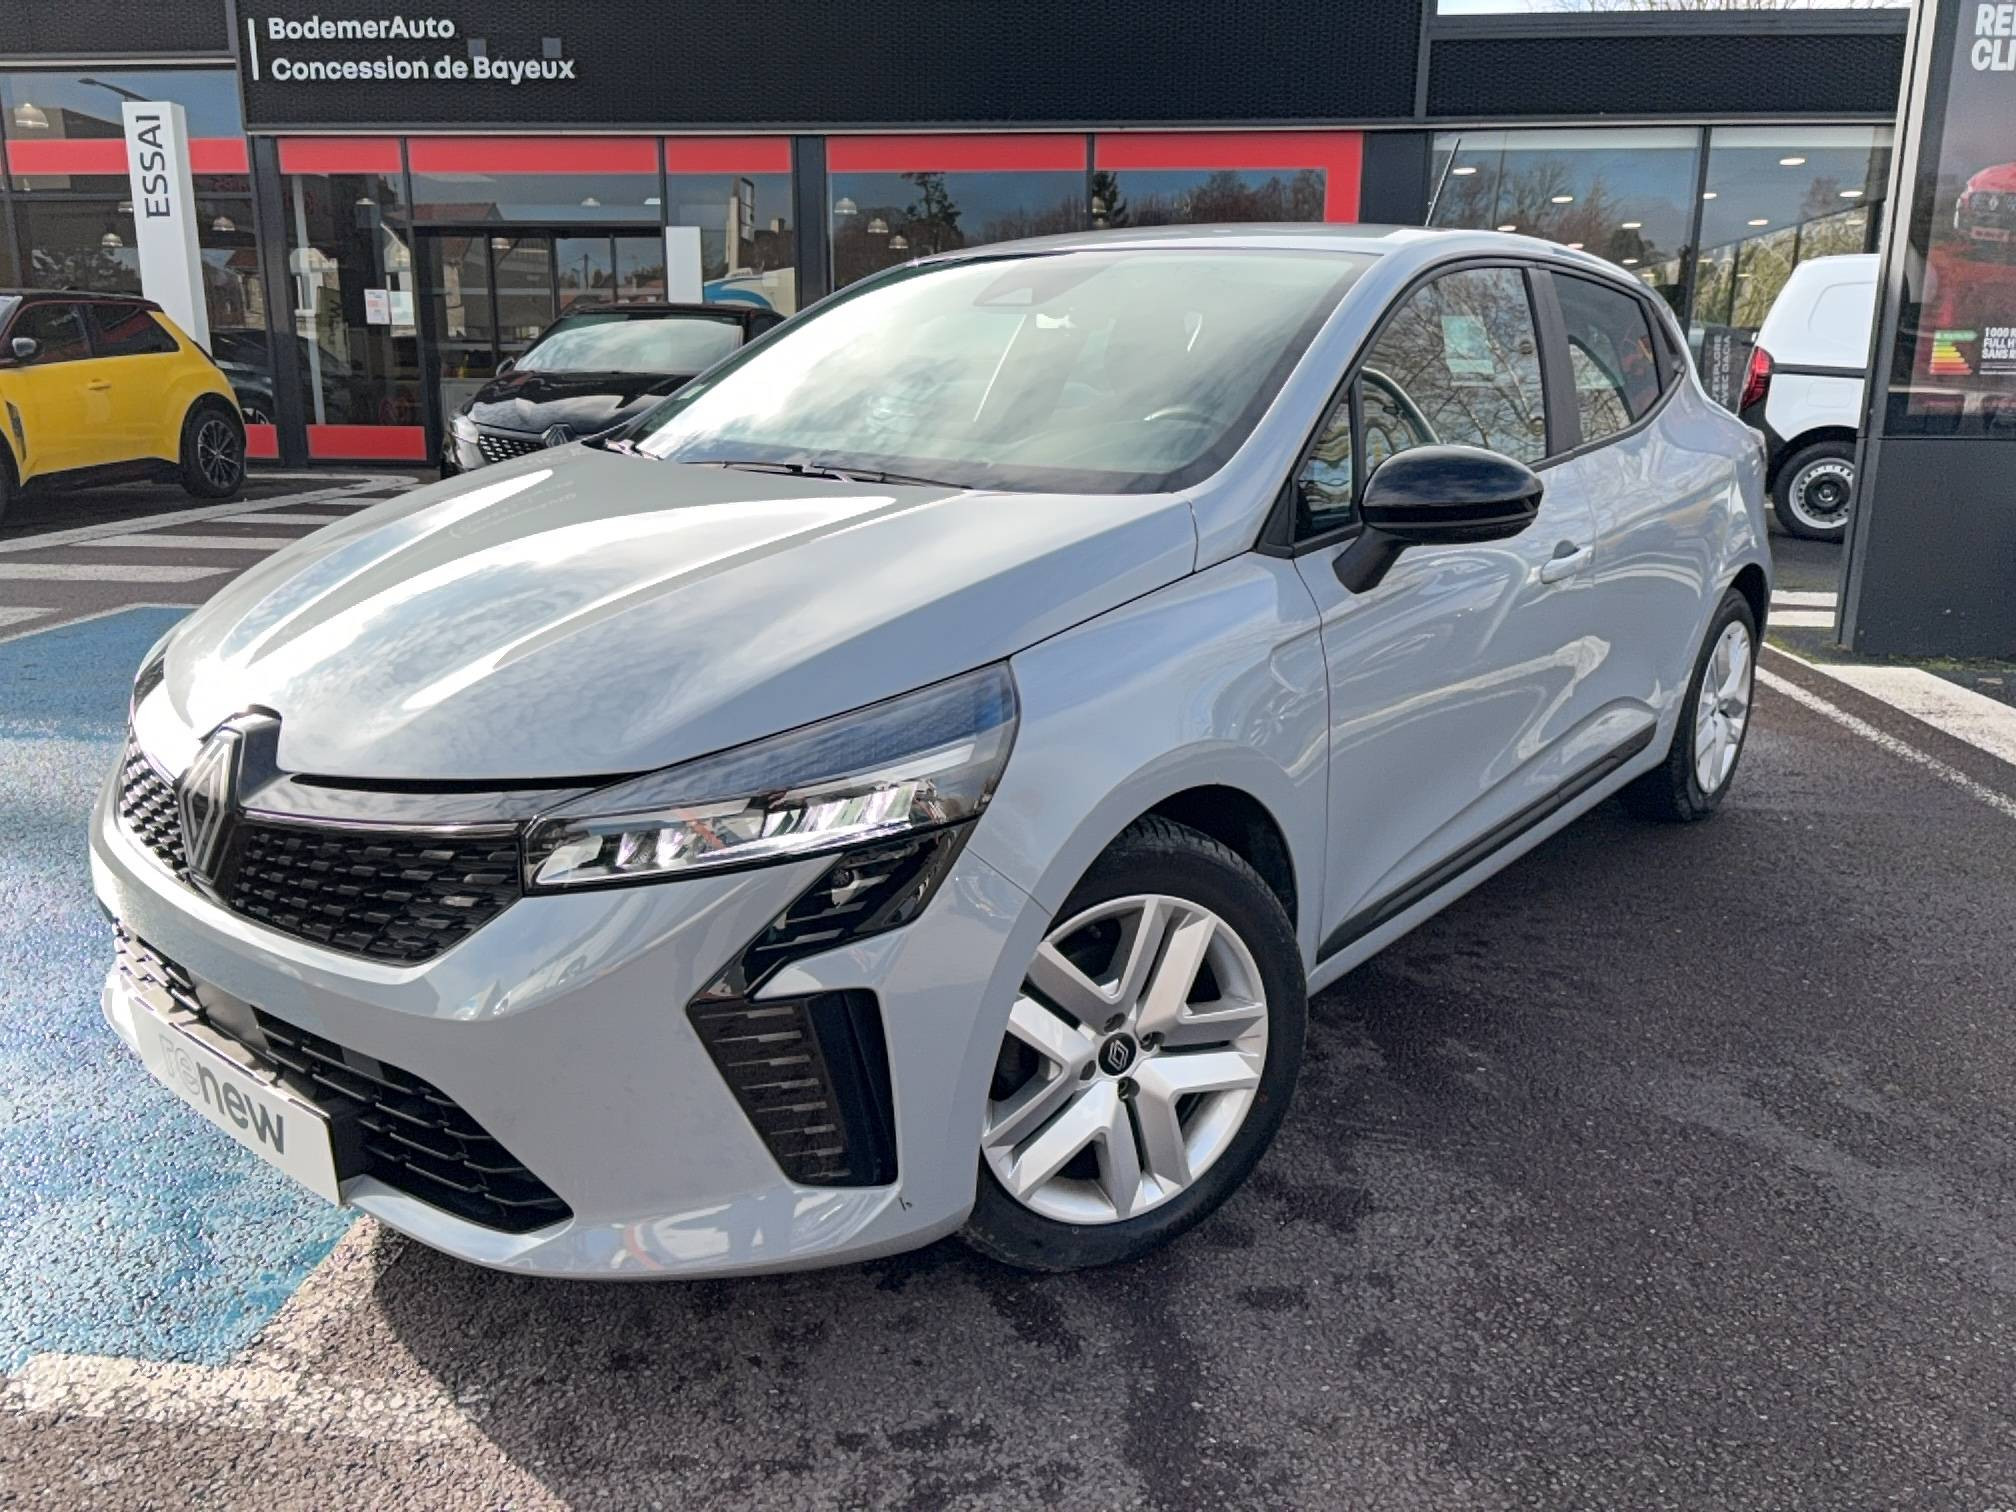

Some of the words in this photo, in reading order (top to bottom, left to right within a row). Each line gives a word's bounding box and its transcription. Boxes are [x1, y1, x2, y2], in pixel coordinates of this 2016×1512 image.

[268, 16, 456, 39] BodemerAuto
[1975, 3, 2016, 36] RE
[271, 55, 430, 80] Concession
[434, 55, 469, 80] de
[473, 55, 576, 85] Bayeux
[1971, 38, 2016, 71] CLI
[135, 115, 171, 218] ESSAI
[1721, 335, 1731, 373] DACIA
[1982, 349, 2008, 359] SANS
[1983, 338, 2006, 348] FULL
[158, 1033, 285, 1155] renew
